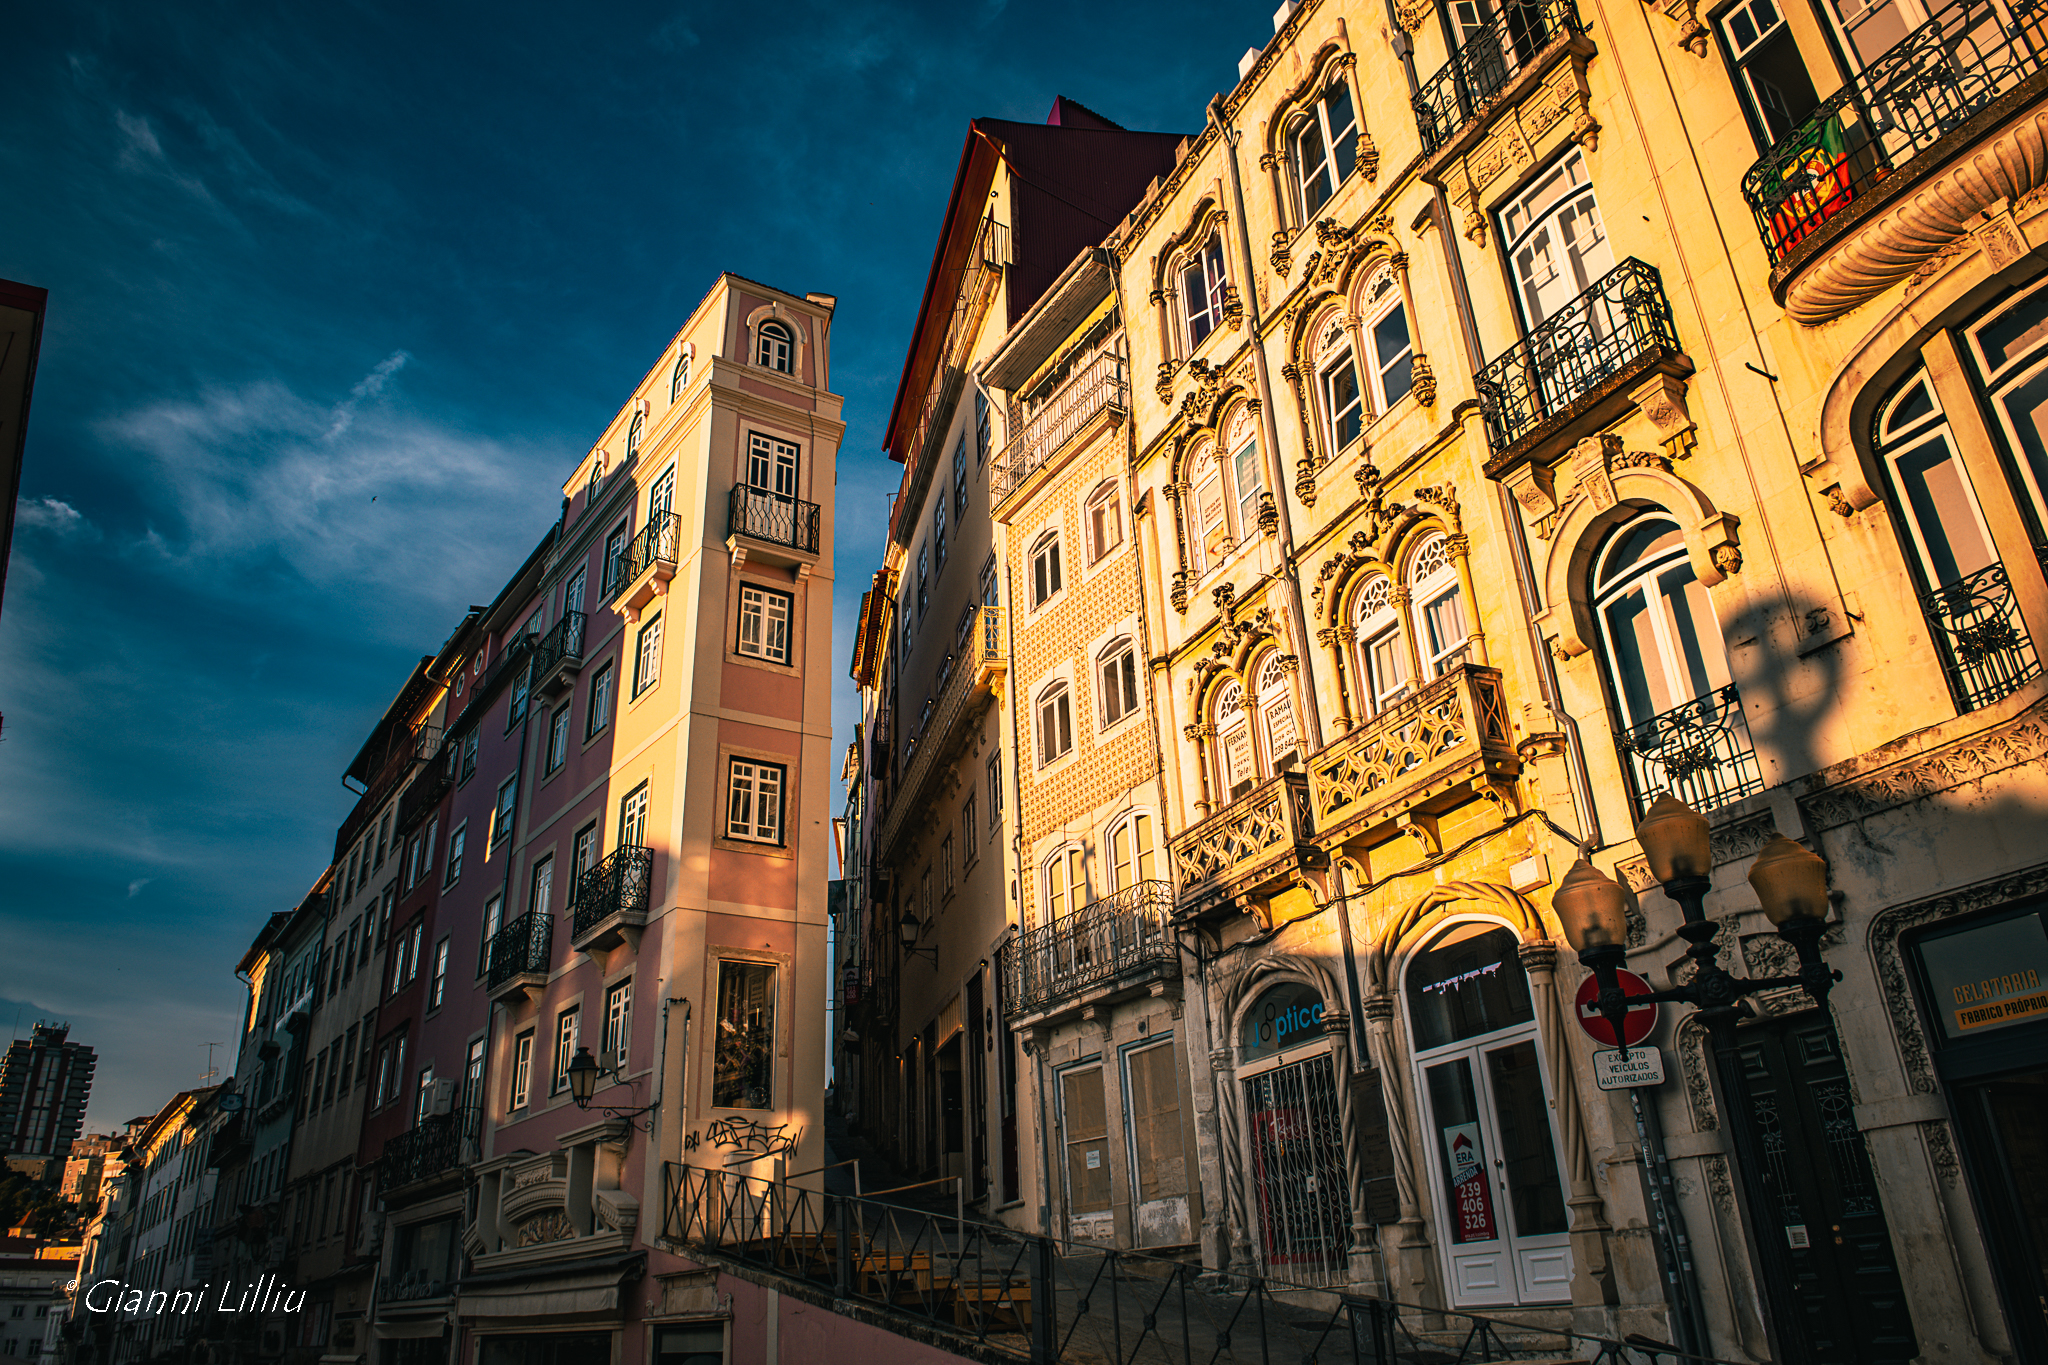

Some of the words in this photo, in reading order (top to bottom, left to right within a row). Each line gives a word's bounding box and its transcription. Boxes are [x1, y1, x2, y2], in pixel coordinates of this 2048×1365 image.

[1952, 969, 2041, 1005] GELATARIA
[1960, 1005, 2004, 1025] FABRICO
[2004, 995, 2048, 1016] PRÓPRIO
[1278, 1055, 1283, 1065] 5
[1608, 1062, 1650, 1073] VEÍCULOS
[1602, 1071, 1659, 1085] AUTORIZADOS
[1456, 1151, 1474, 1163] ERA
[1453, 1165, 1479, 1188] ARRENDA
[1460, 1181, 1481, 1198] 239
[1462, 1197, 1484, 1213] 406
[1464, 1213, 1486, 1230] 326
